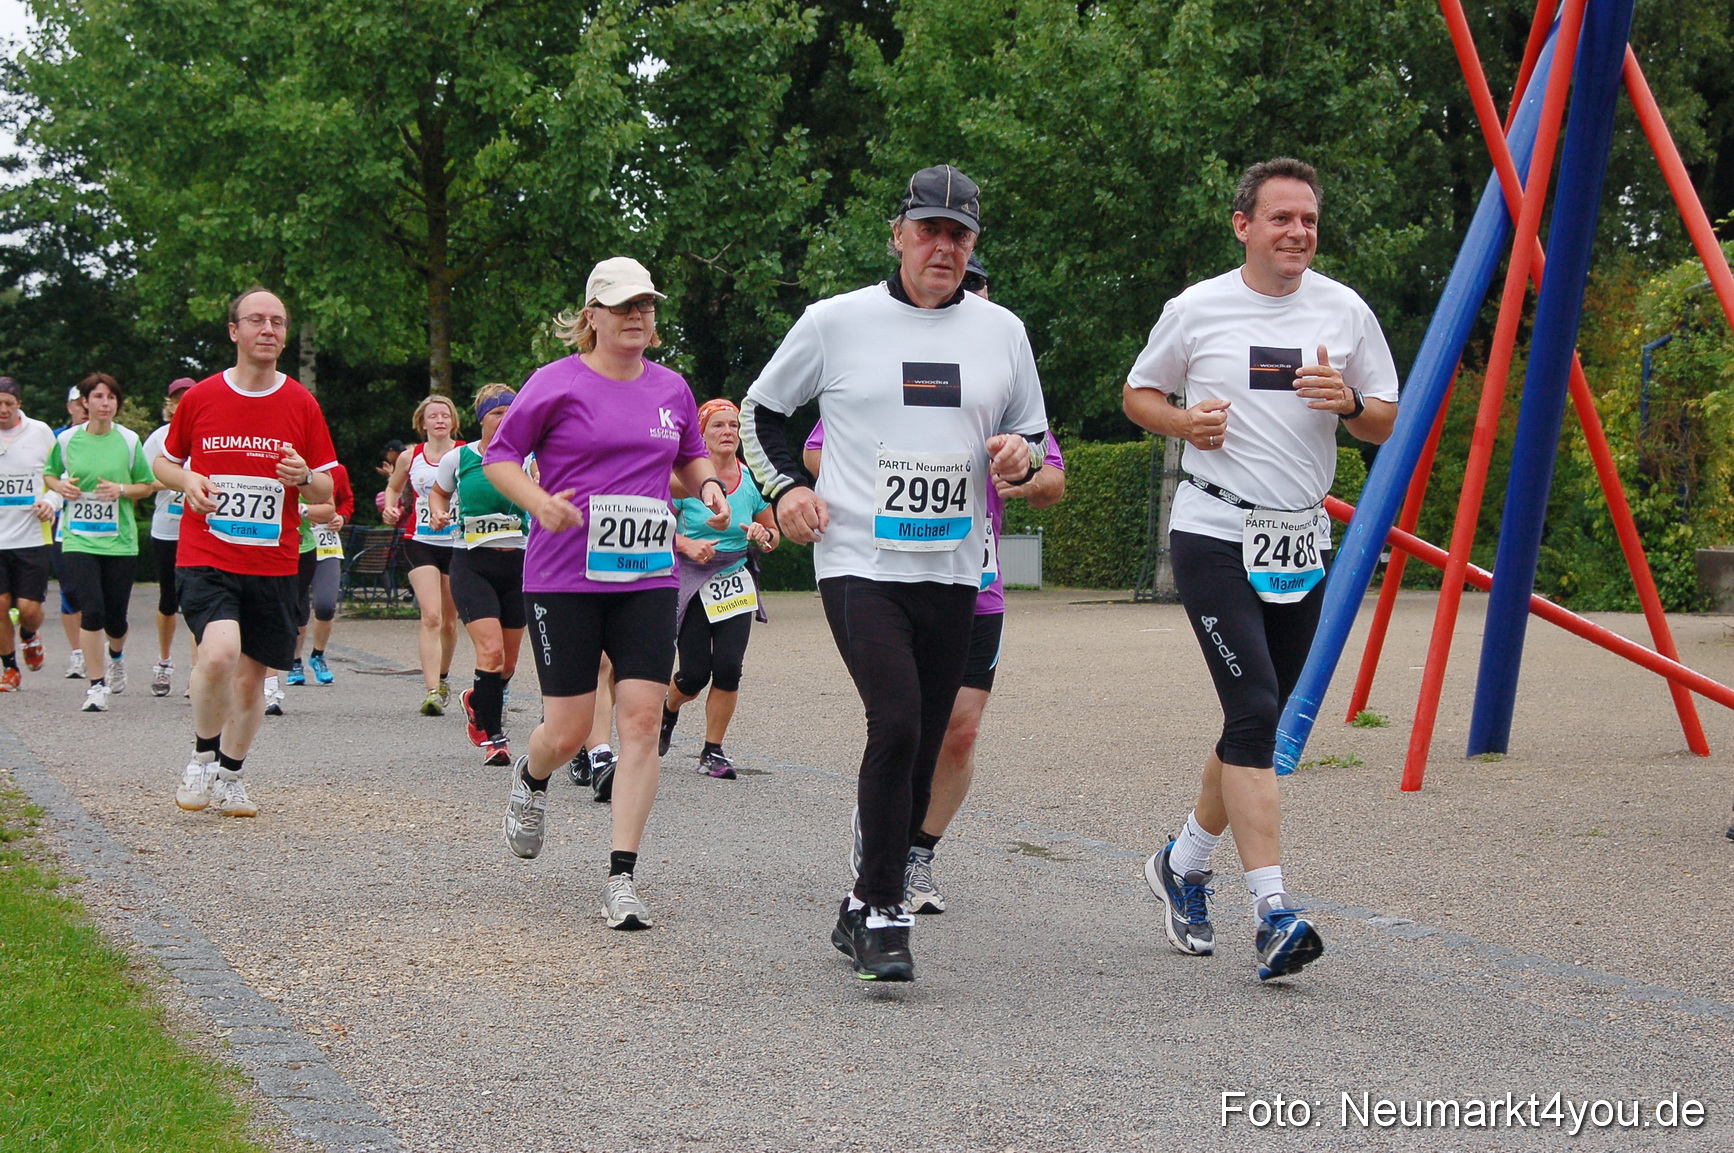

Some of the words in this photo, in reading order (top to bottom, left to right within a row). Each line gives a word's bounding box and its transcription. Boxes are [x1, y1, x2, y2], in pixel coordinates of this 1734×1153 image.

[658, 407, 675, 429] K
[202, 436, 280, 451] NEUMARKT
[879, 460, 913, 471] PARTL
[915, 463, 963, 473] Neumarkt
[0, 479, 34, 495] 2674
[236, 483, 272, 491] Neumarkt
[885, 475, 967, 514] 2994
[74, 503, 114, 519] 2834
[215, 492, 276, 520] 2373
[592, 504, 622, 512] PARTL
[625, 505, 660, 514] Neumarkt
[231, 524, 258, 536] Frank
[899, 522, 950, 538] Michael
[1245, 520, 1278, 528] PARTL
[598, 517, 668, 548] 2044
[1253, 532, 1317, 568] 2488
[617, 556, 648, 570] Sandi
[709, 576, 744, 601] 329
[1269, 576, 1305, 590] Martin
[716, 598, 749, 613] Christine
[538, 621, 551, 666] odlo
[1211, 631, 1242, 677] odlo
